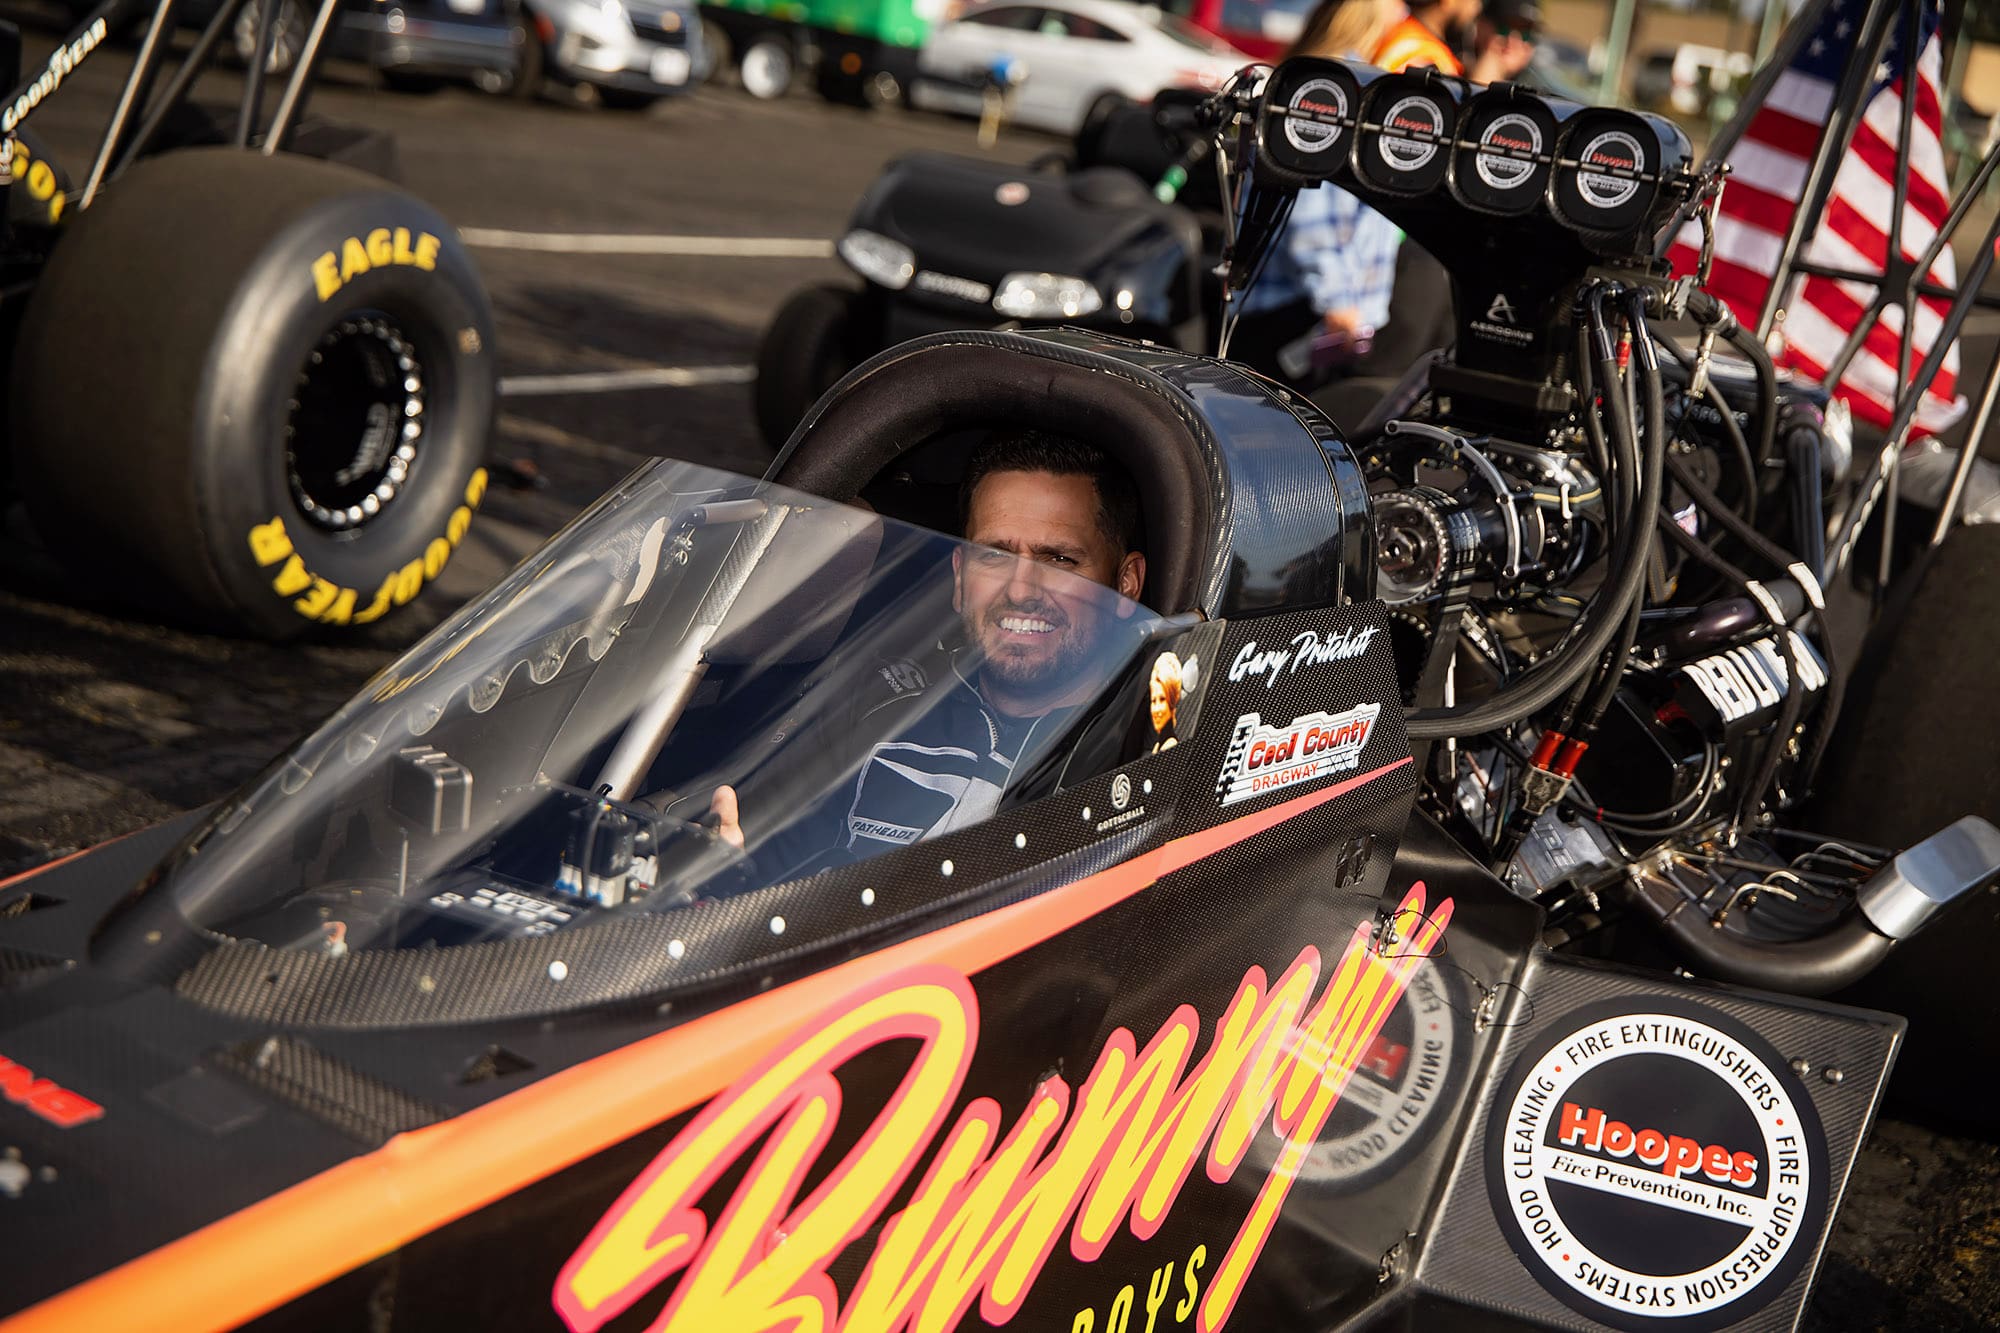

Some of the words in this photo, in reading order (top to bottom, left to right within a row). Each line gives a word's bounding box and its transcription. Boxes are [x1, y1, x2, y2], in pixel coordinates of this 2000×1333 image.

[1592, 151, 1633, 169] Hoopes
[310, 226, 442, 303] EAGLE
[248, 467, 489, 625] GOODYEAR
[1228, 641, 1291, 688] Gary
[1290, 625, 1380, 673] Pritchett
[1303, 718, 1371, 757] County
[1252, 762, 1319, 792] DRAGWAY
[1097, 805, 1145, 831] GOTTSCHALK
[1565, 1030, 1613, 1066] FIRE
[1620, 1023, 1780, 1111] EXTINGUISHERS
[553, 879, 1455, 1333] Bunny
[1513, 1076, 1556, 1179] CLEANING
[1558, 1102, 1759, 1188] Hoopes
[1775, 1136, 1799, 1185] FIRE
[1551, 1155, 1592, 1177] Fire
[1594, 1165, 1711, 1209] Prevention,
[1715, 1194, 1753, 1218] Inc.
[1519, 1189, 1562, 1250] HOOD
[1684, 1192, 1797, 1305] SUPPRESSION
[1574, 1261, 1676, 1307] SYSTEMS
